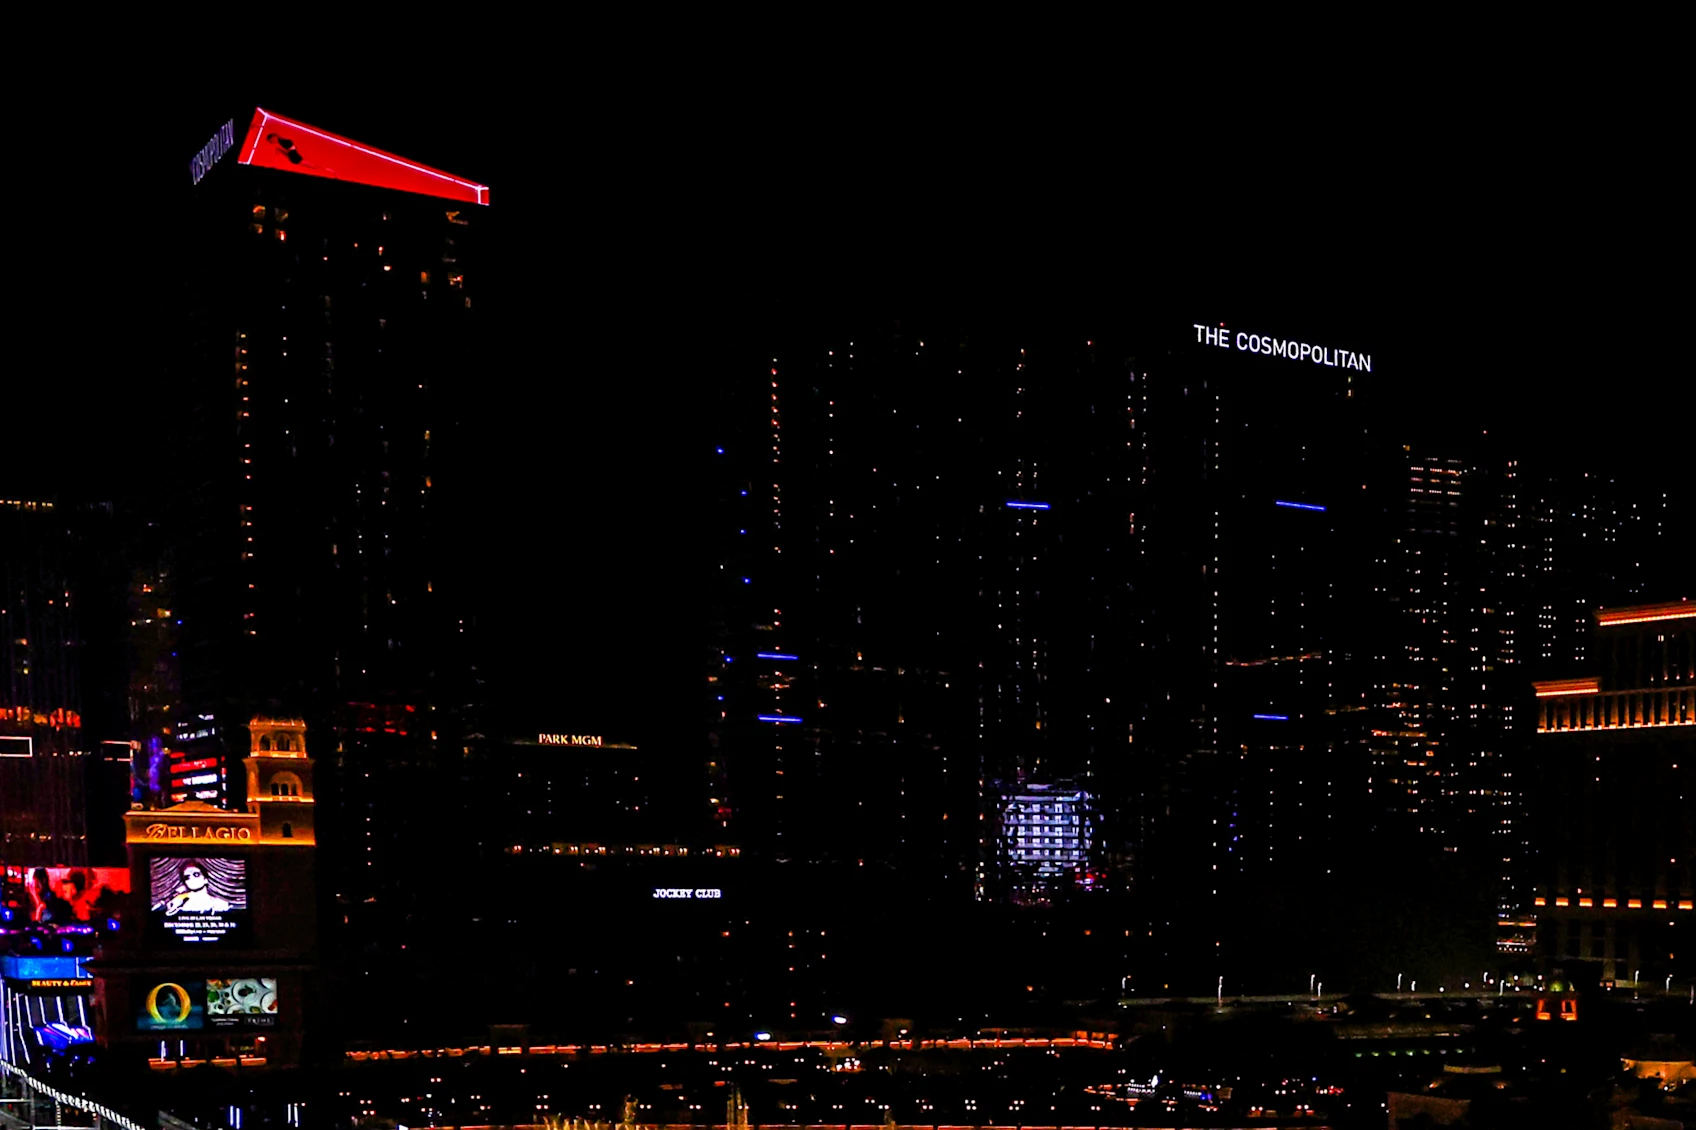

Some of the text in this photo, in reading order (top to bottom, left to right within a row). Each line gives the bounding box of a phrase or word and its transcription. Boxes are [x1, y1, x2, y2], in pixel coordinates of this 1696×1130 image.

[1193, 323, 1371, 372] THE COSMOPOLITAN
[538, 733, 602, 746] PARK MGM
[146, 823, 250, 840] BELLAGIO
[653, 889, 721, 898] JOCKEY CLUB
